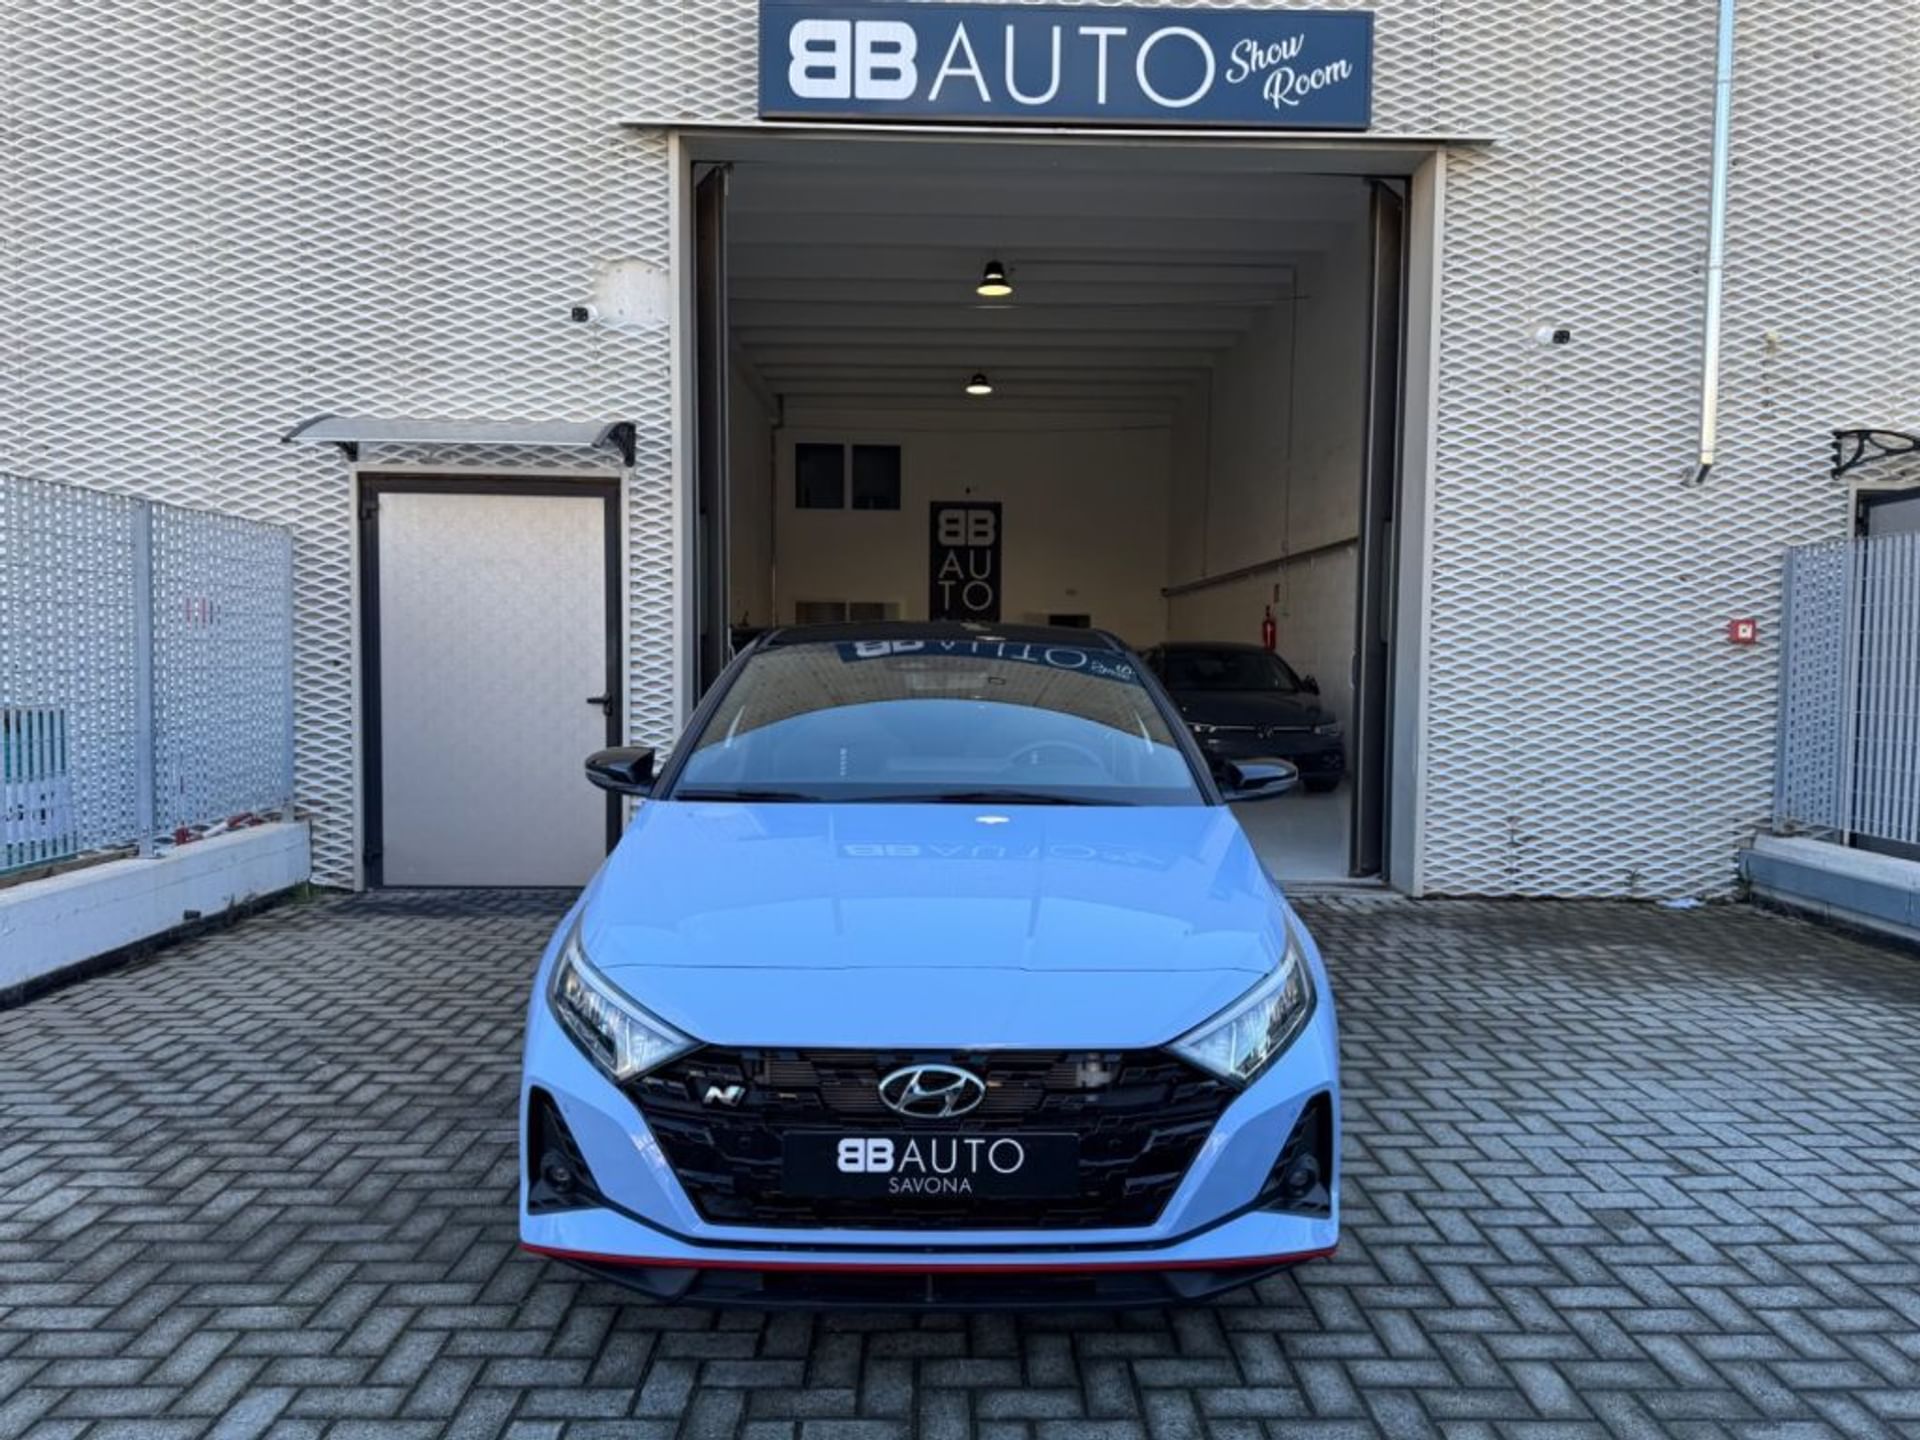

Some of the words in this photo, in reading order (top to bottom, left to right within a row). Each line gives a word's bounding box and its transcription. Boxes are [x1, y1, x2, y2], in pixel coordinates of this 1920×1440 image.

[1226, 33, 1304, 84] Show
[1263, 59, 1353, 109] Room
[938, 509, 995, 546] BB
[888, 1177, 973, 1194] SAVONA
